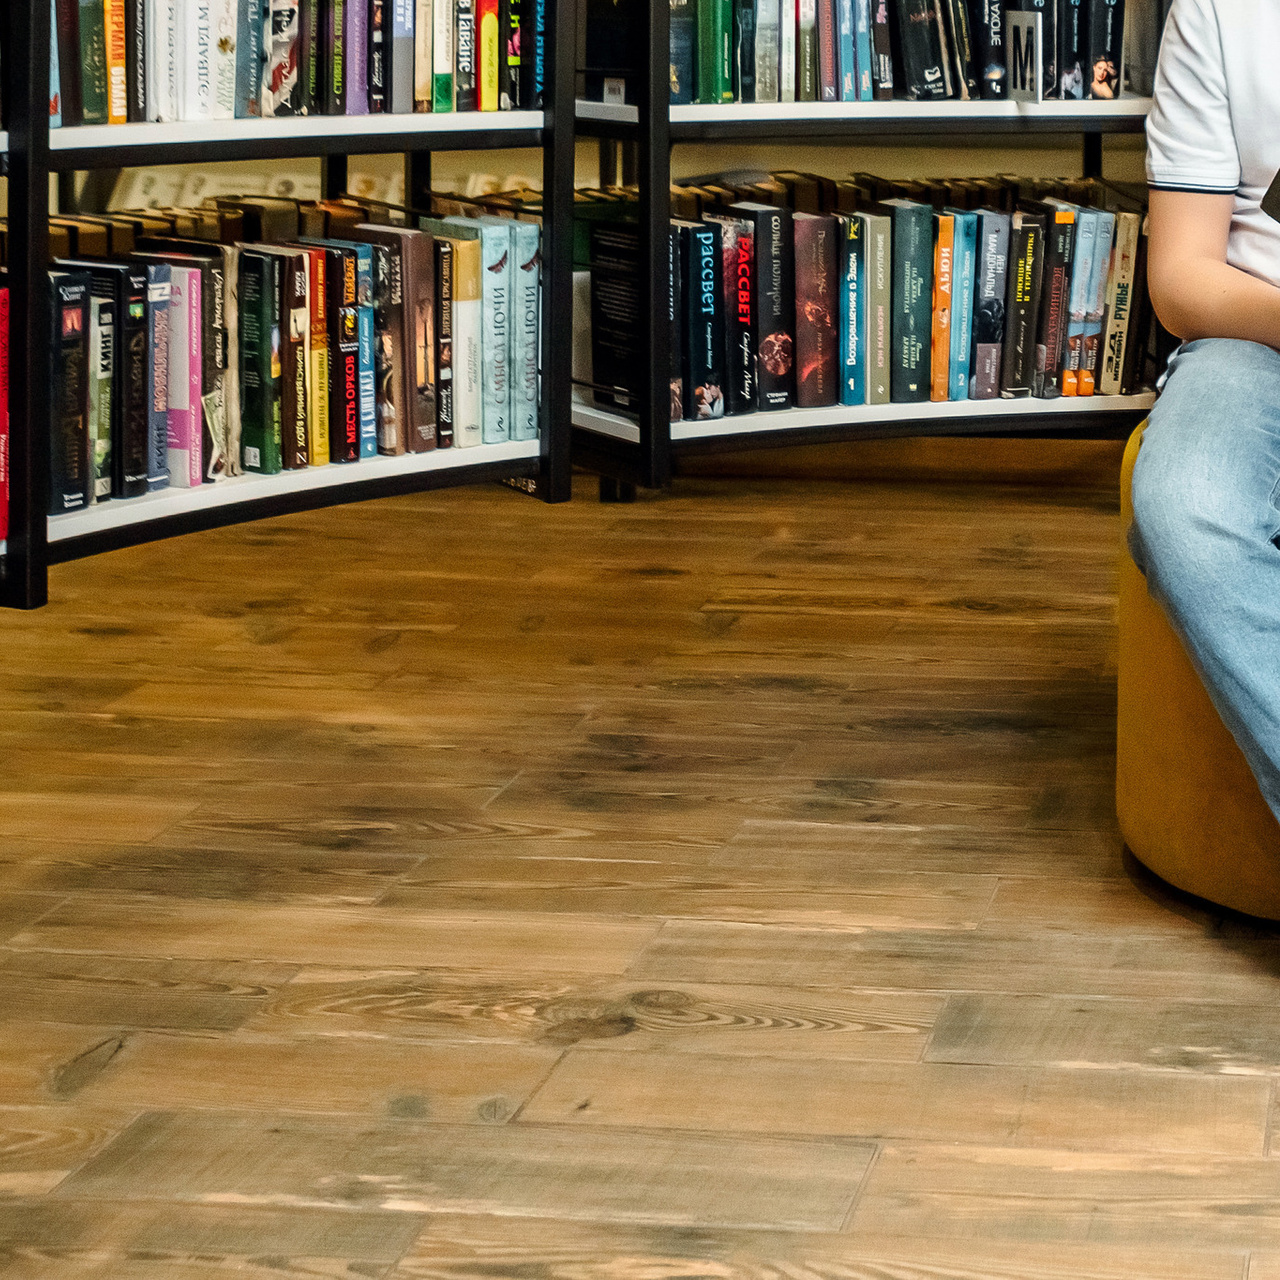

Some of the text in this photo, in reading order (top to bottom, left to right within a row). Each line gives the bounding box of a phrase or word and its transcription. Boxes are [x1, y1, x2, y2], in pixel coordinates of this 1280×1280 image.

[824, 13, 833, 82] СТОЛКНОВЕНИЯ
[991, 3, 1001, 46] ЭПОХА
[1012, 25, 1034, 92] М
[198, 26, 210, 97] ЭДВАРД
[278, 48, 294, 108] Дуглас
[333, 56, 343, 94] СТИВЕН
[441, 253, 451, 336] ДНЕВНАЯ КРАСАВИЦА
[696, 231, 715, 316] рассвет
[737, 236, 751, 326] РАССВЕТ
[847, 252, 857, 281] Эдем
[940, 247, 950, 294] ДЬЮИ
[984, 234, 998, 298] МАКДОНАЛЬД
[996, 255, 1005, 273] ЙЕН
[1016, 257, 1025, 302] ПОЮЩИЕ
[846, 290, 858, 366] Возвращение
[1049, 267, 1063, 337] ХЕМИНГУЭЯ
[1114, 282, 1129, 321] РУЖЬЕ
[100, 330, 112, 373] КИНГ
[154, 308, 168, 412] МОБИЛЬНИК
[492, 286, 506, 404] СМЫСЛ НОЧИ
[523, 285, 537, 402] СМЫСЛ НОЧИ
[1107, 331, 1116, 373] ЭД
[296, 346, 306, 448] ЕДИНСТВЕННЫЙ ВДОХ
[345, 355, 357, 444] МЕСТЬ ОРКОВ
